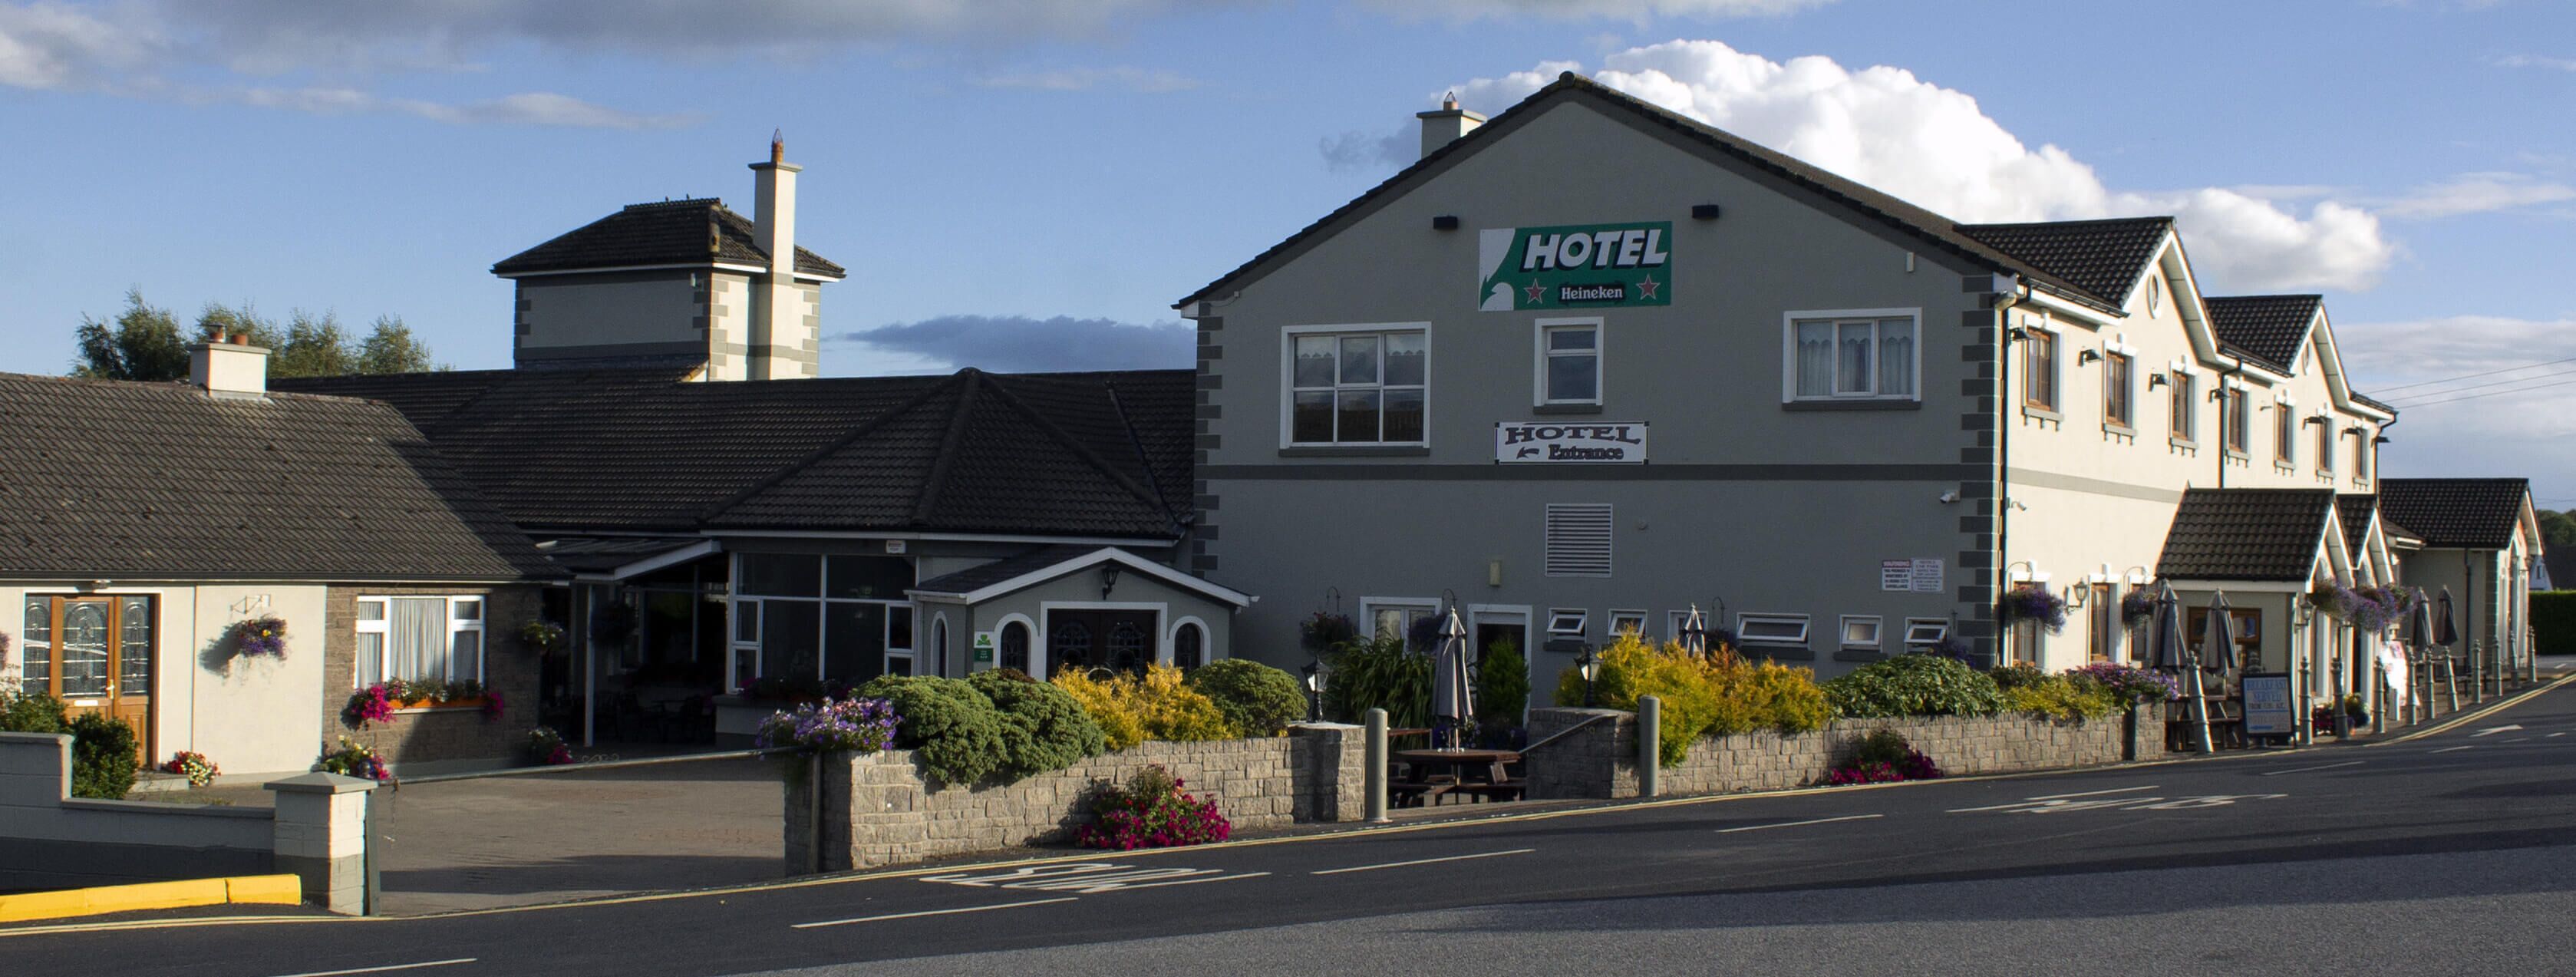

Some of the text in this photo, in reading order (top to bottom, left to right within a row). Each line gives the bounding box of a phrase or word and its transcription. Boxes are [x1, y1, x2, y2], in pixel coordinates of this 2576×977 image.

[1521, 229, 1668, 270] HOTEL
[1561, 286, 1624, 300] Heineken
[1505, 425, 1641, 445] HOTEL
[1548, 444, 1624, 460] Entrance
[919, 863, 1272, 894] SLOW
